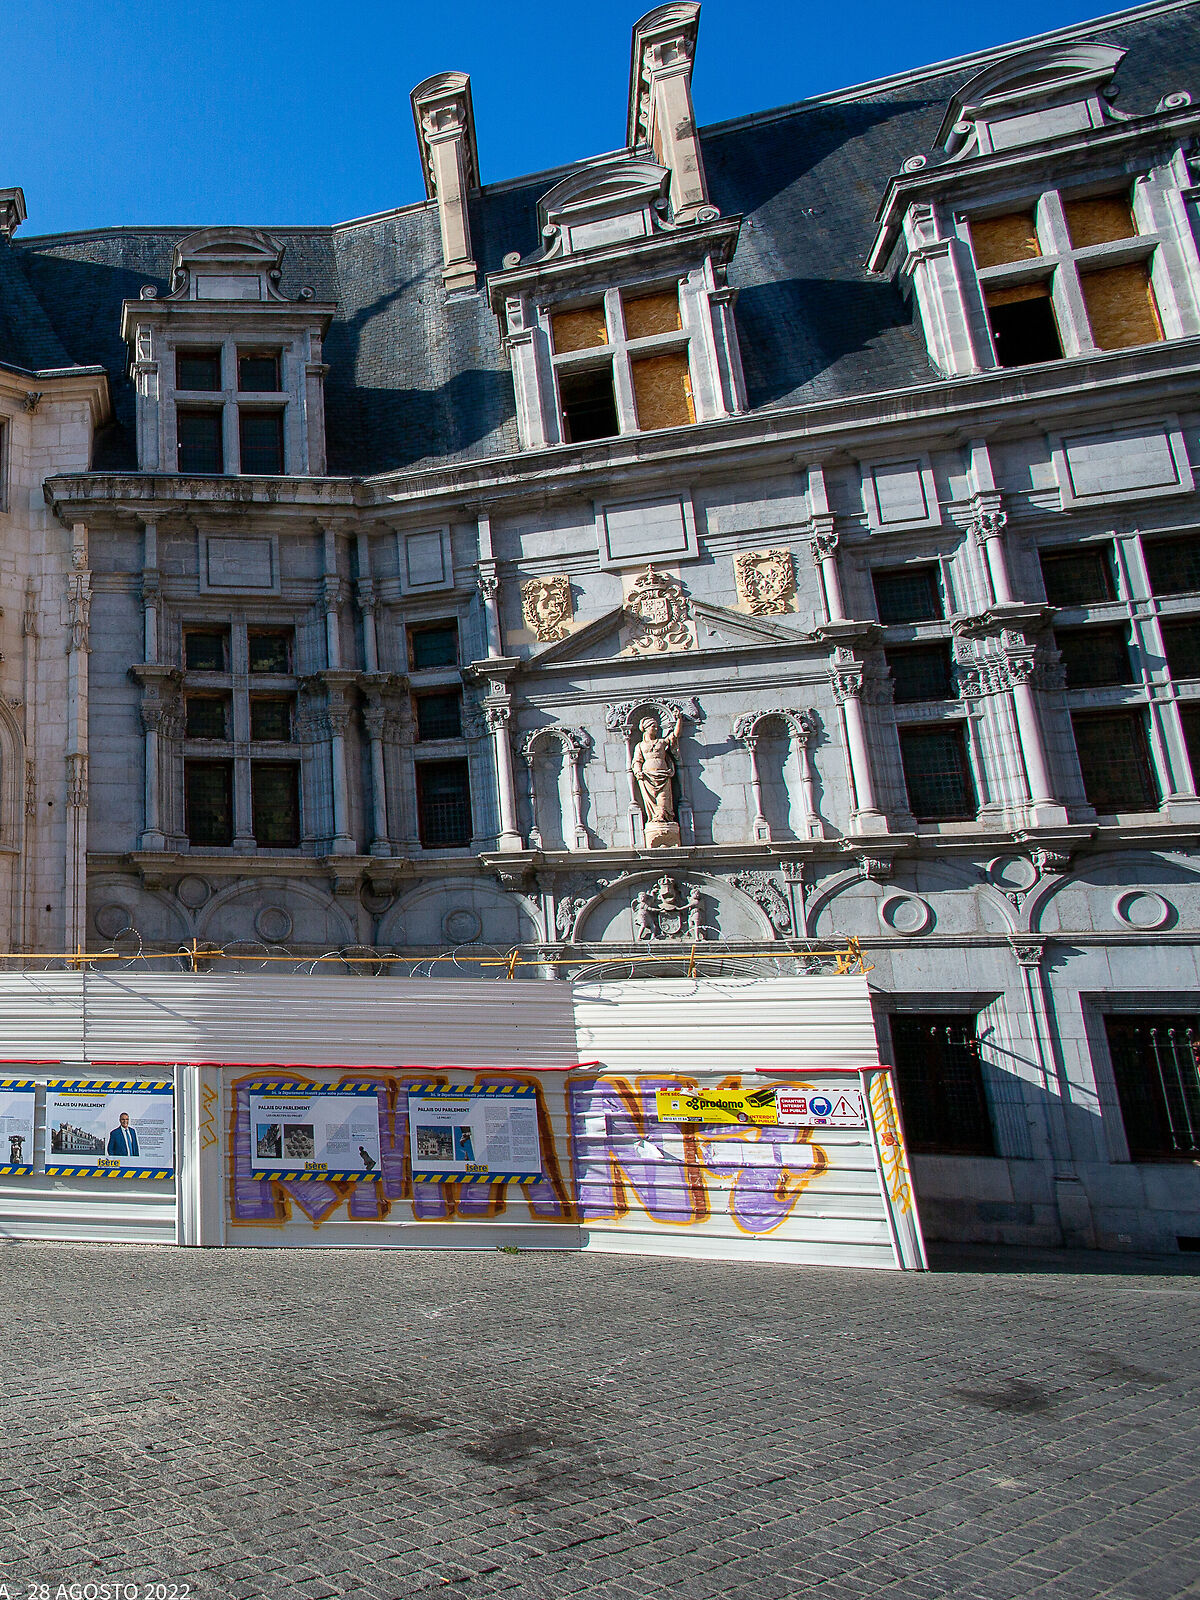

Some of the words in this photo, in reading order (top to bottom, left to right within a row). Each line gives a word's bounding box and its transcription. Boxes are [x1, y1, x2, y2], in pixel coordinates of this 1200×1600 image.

[699, 1098, 744, 1111] prodomo
[98, 1158, 119, 1167] isère
[304, 1161, 327, 1171] isère
[465, 1163, 488, 1172] isère
